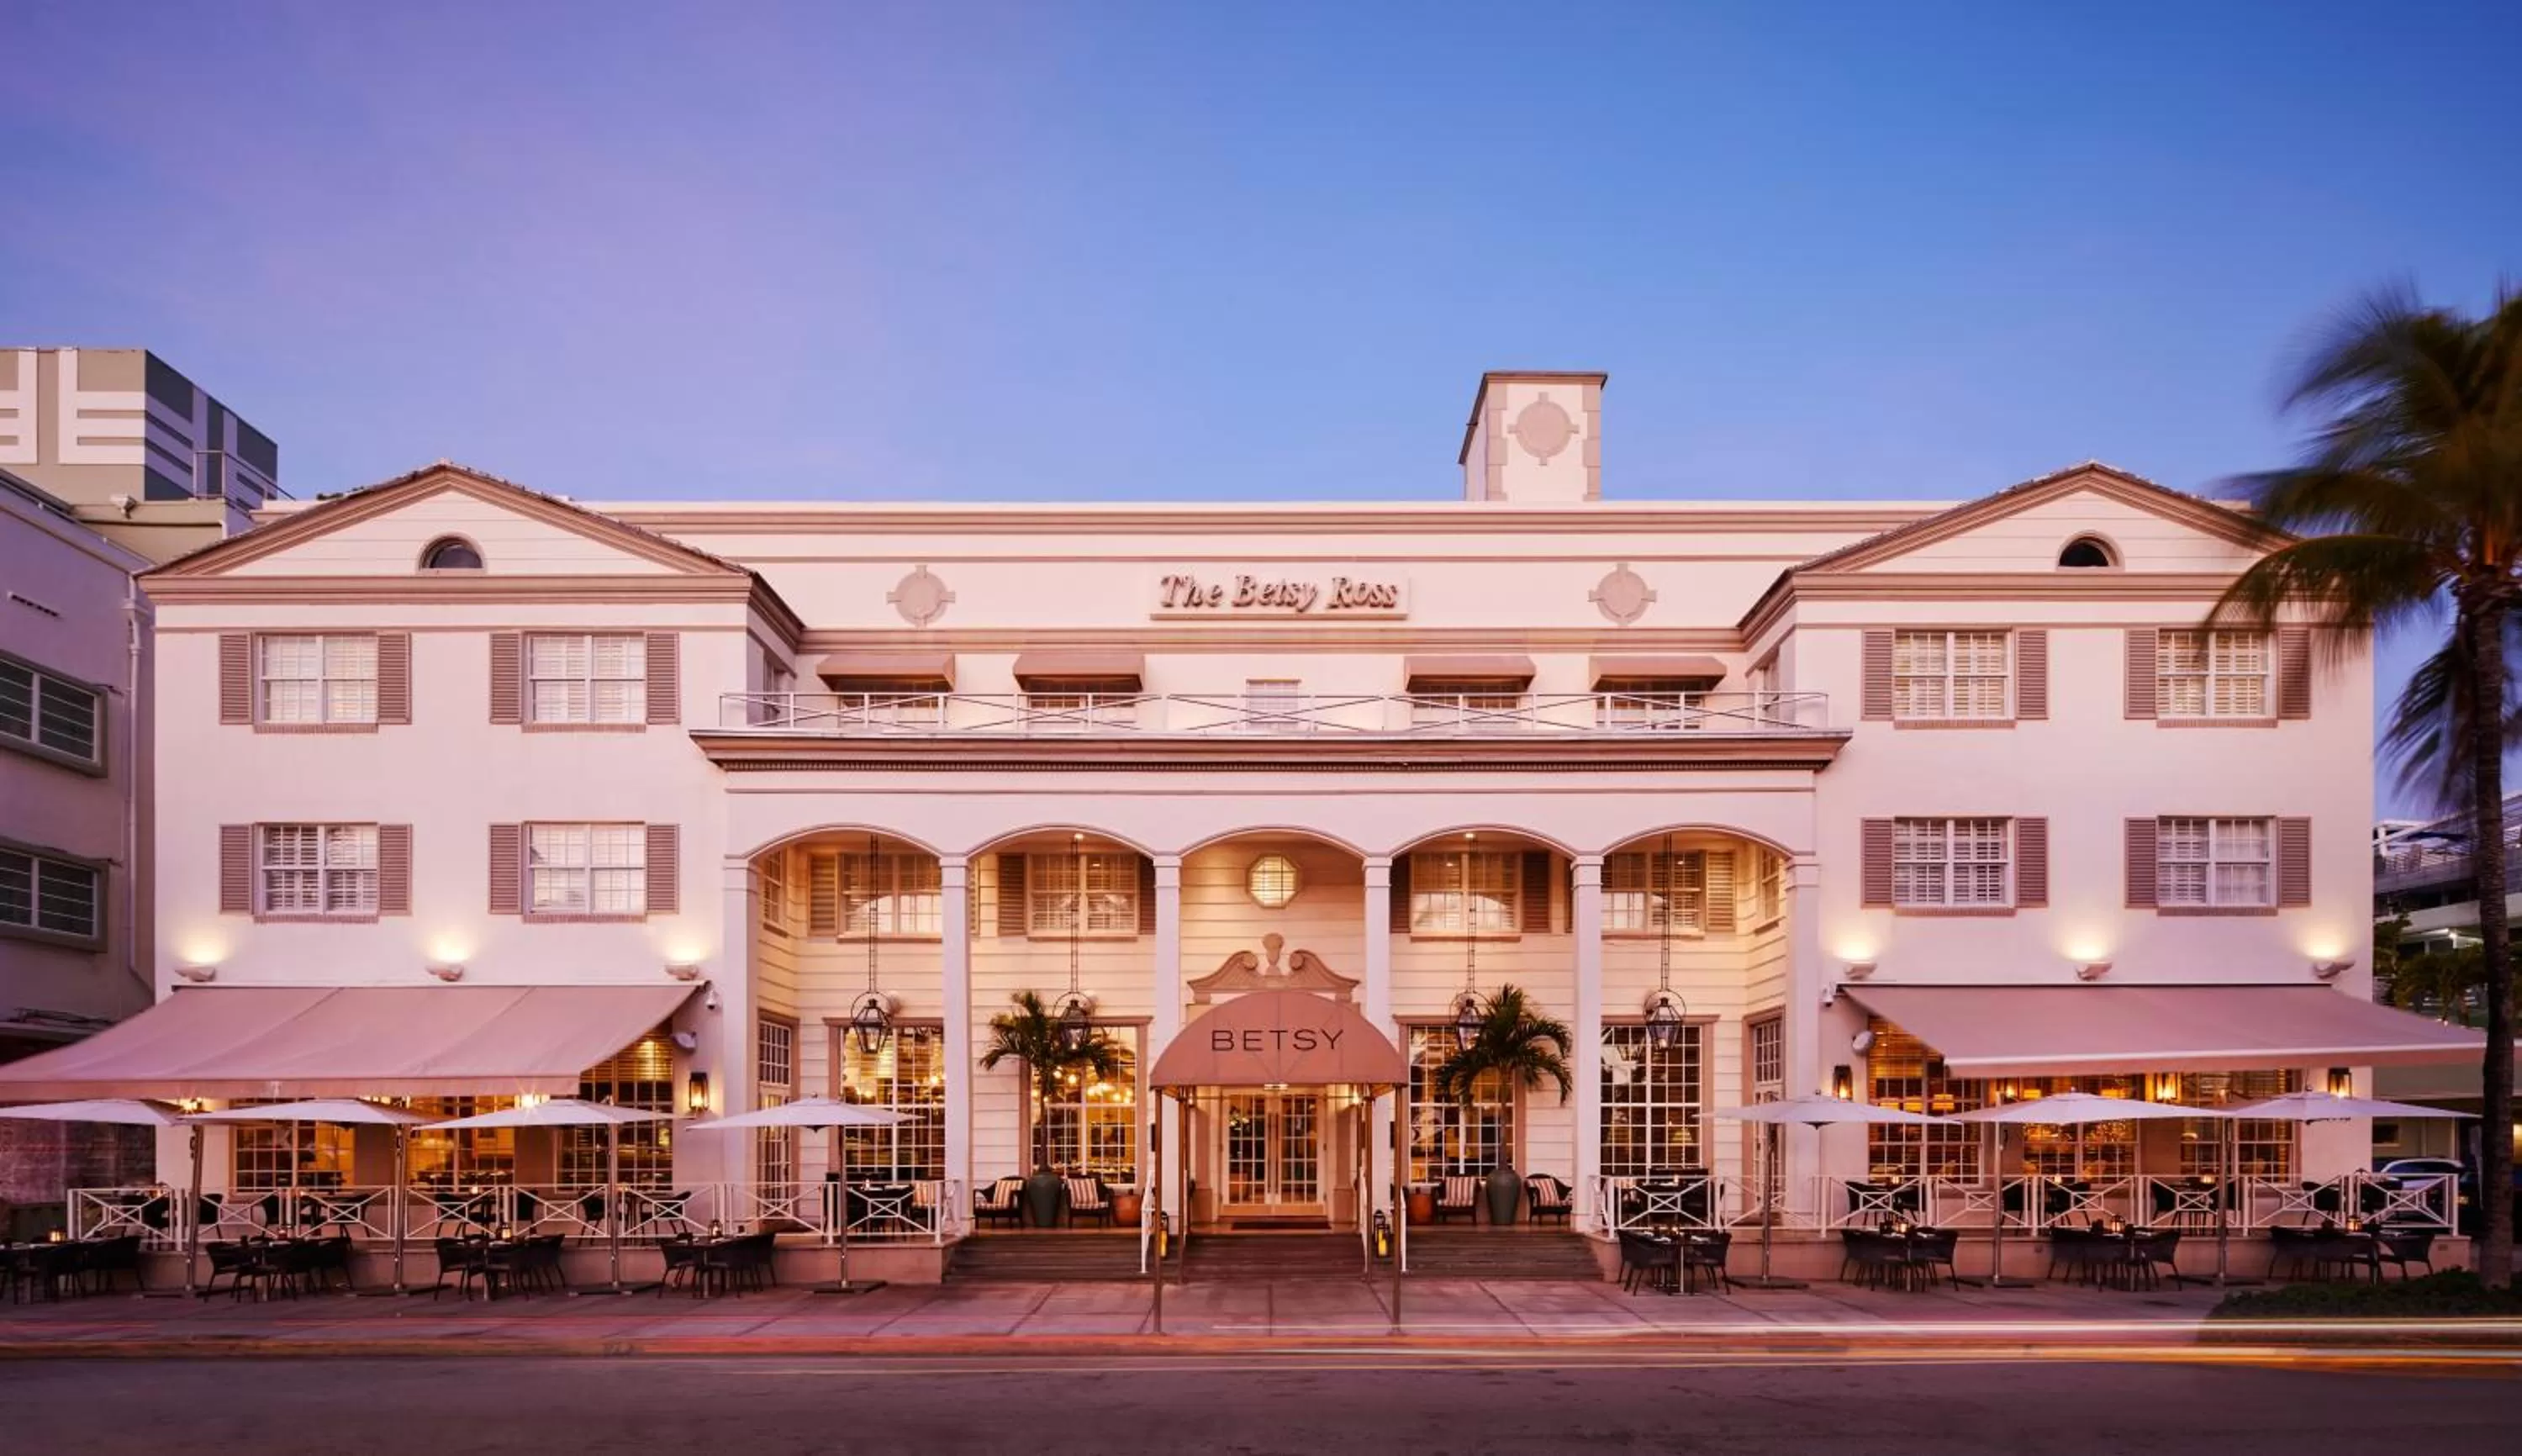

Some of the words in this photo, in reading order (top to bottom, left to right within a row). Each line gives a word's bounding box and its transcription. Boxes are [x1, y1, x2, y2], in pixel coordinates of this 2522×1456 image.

[1160, 574, 1224, 608] The
[1231, 574, 1319, 613] Betsy
[1326, 576, 1399, 609] Ross
[1211, 1029, 1344, 1052] BETSY
